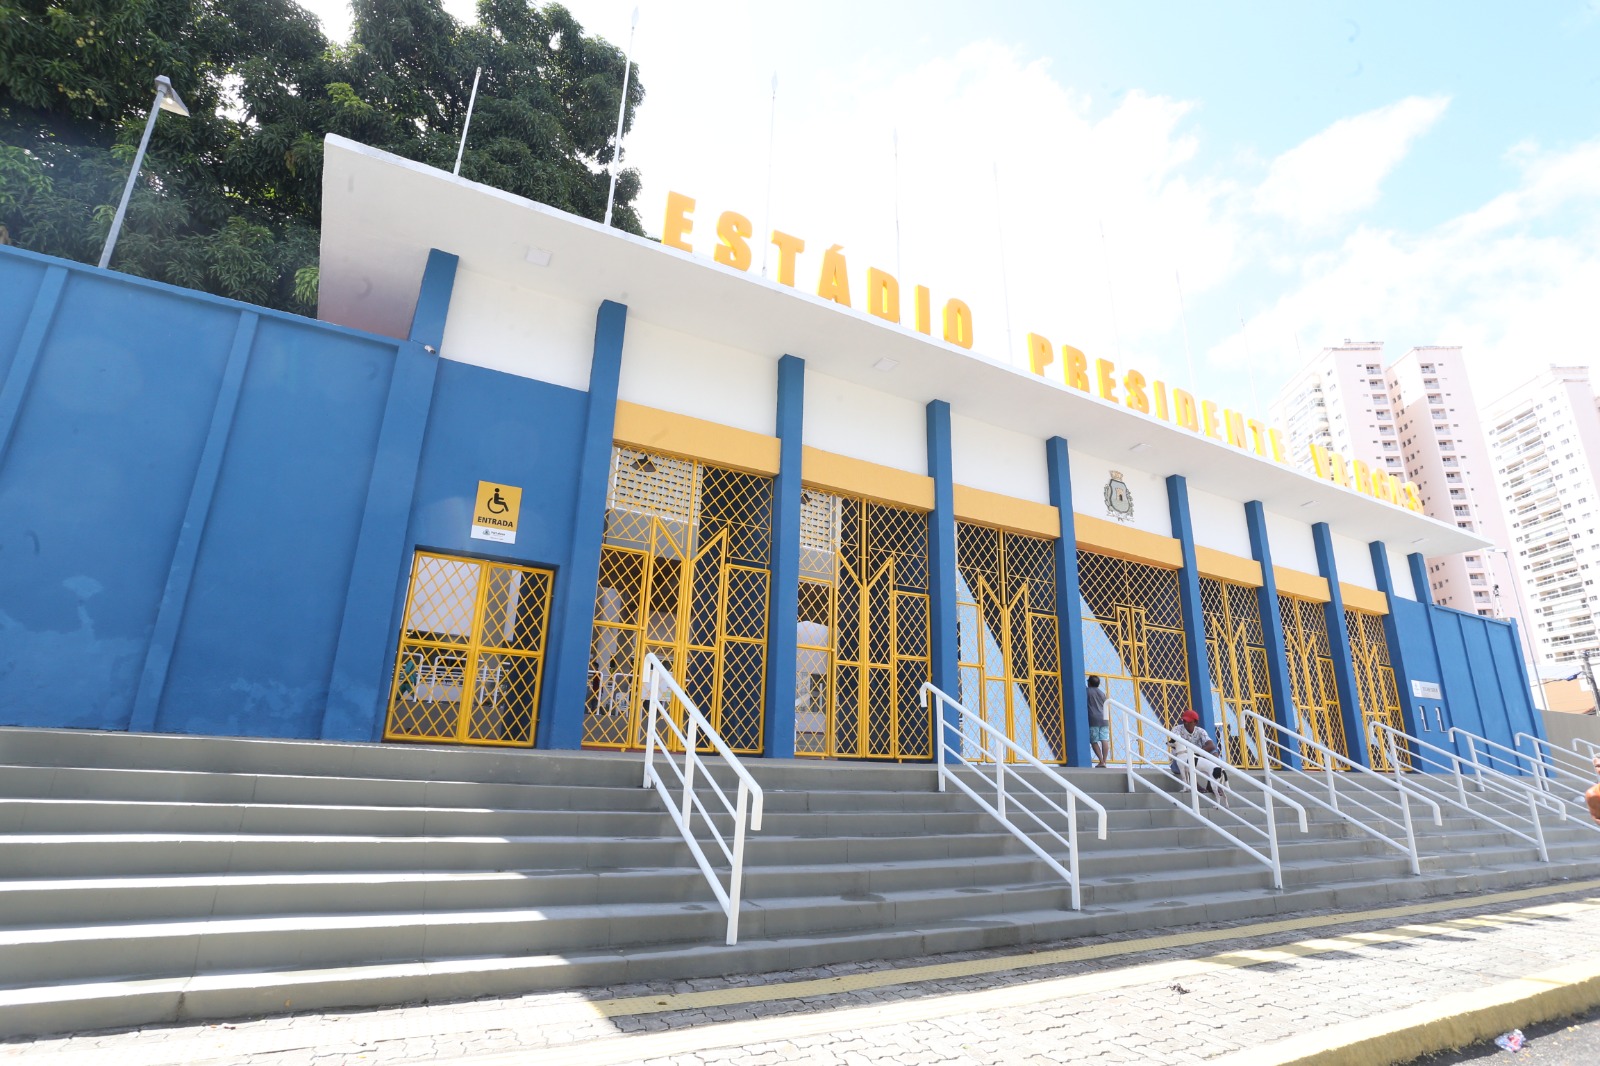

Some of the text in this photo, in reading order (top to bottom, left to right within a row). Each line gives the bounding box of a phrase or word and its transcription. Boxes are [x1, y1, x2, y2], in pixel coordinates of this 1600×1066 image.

[661, 190, 1425, 515] ESTÁDIO PRESIDENTE VARGAS
[477, 516, 514, 528] ENTRADA
